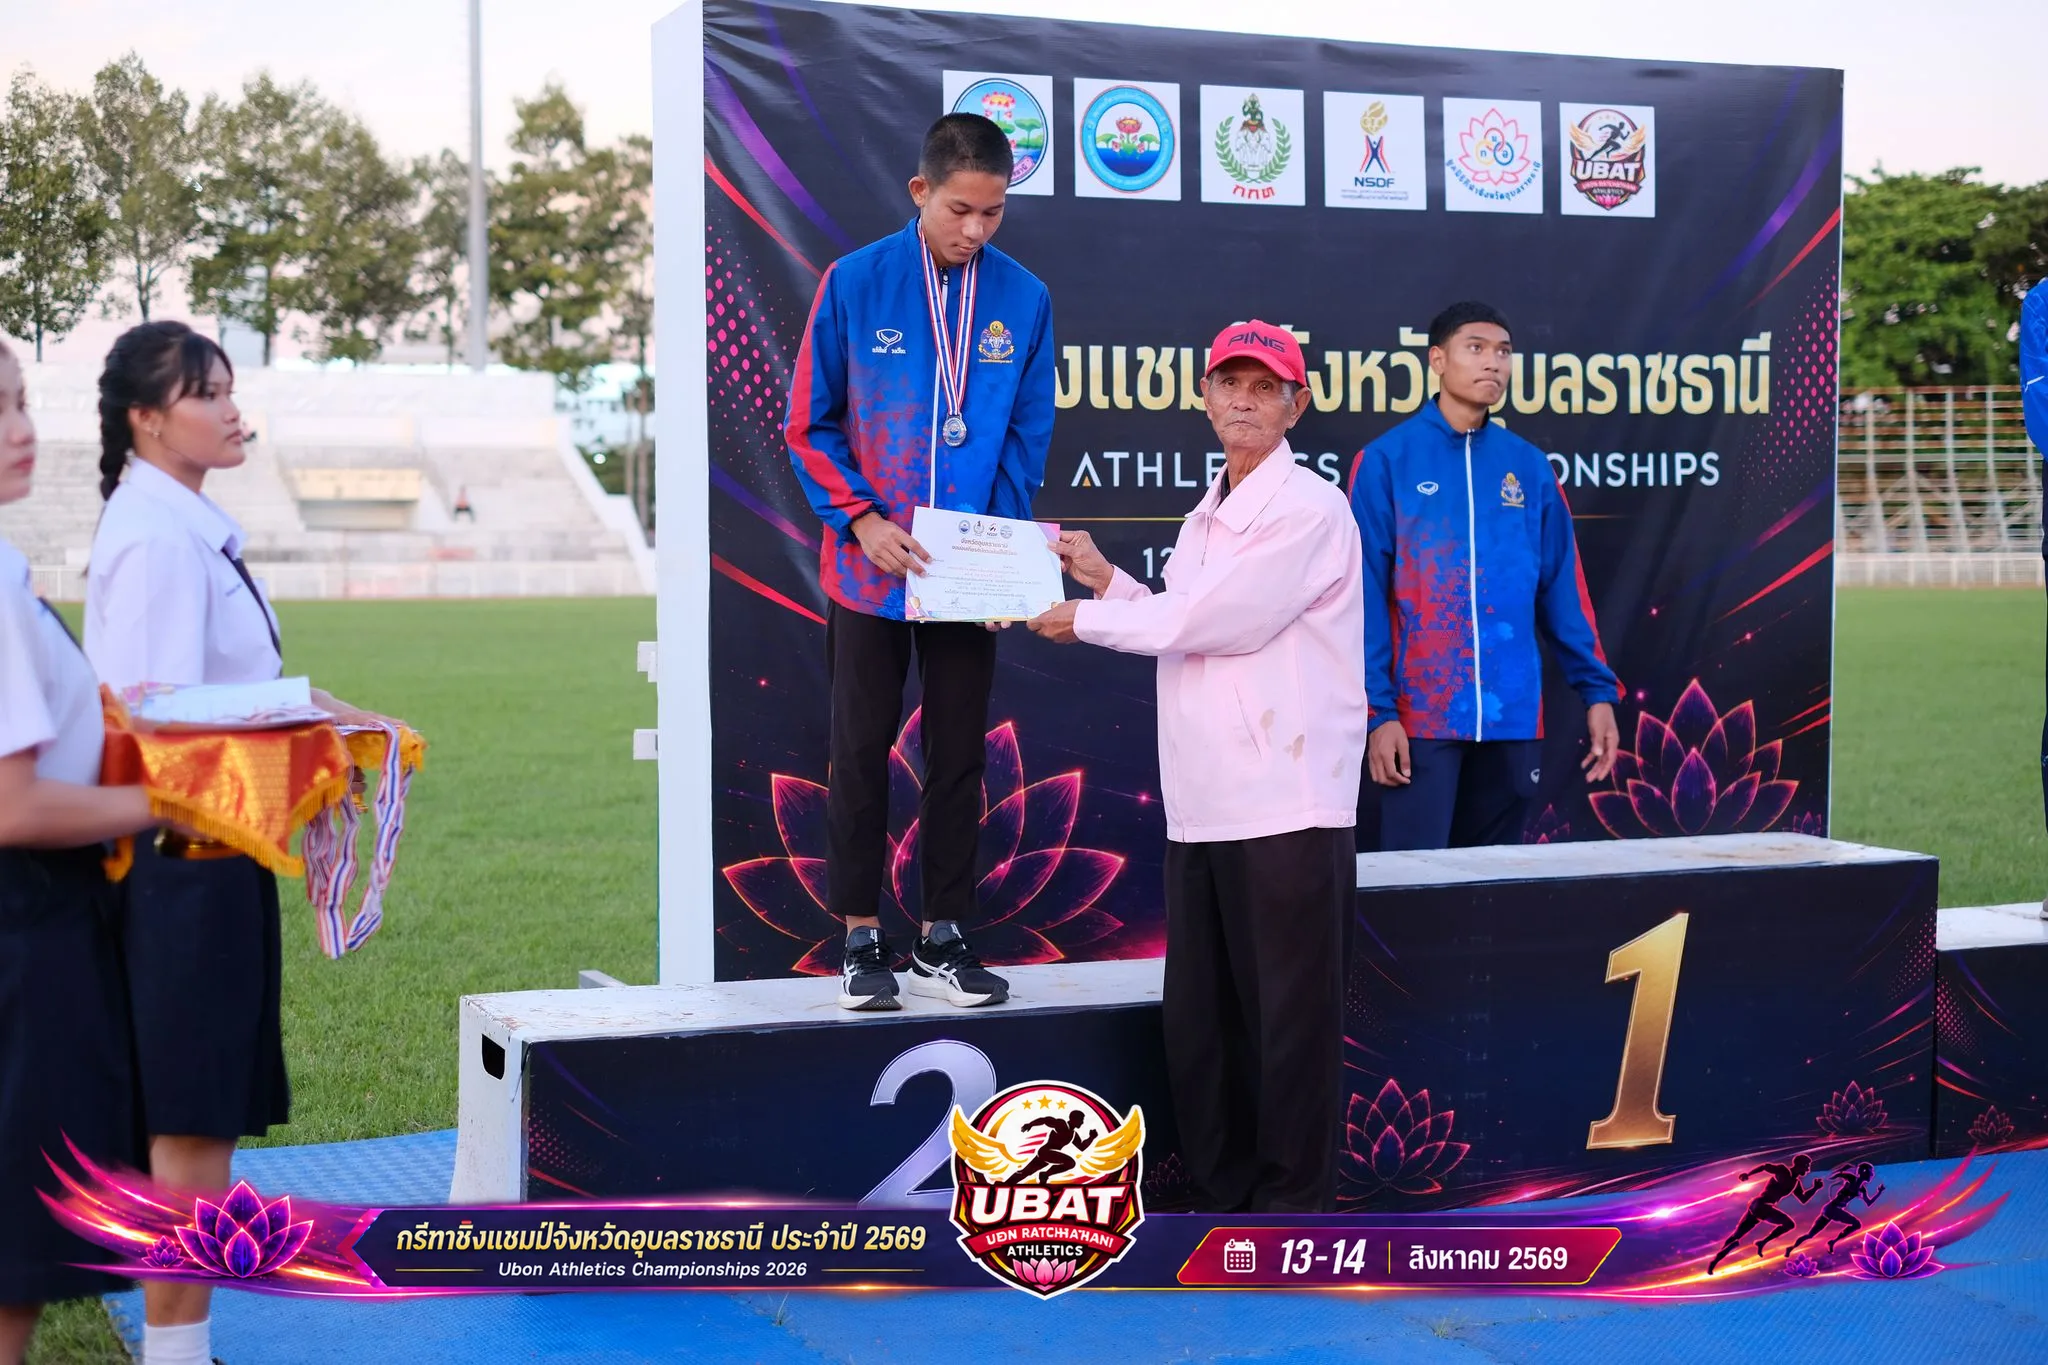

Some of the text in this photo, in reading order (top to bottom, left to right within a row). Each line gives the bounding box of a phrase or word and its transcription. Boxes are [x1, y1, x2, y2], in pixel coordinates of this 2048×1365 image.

[1354, 176, 1395, 188] NSDF
[1576, 160, 1640, 182] UBAT
[1232, 184, 1275, 200] กกท
[1227, 331, 1286, 353] PING
[1586, 912, 1690, 1150] 1
[859, 1040, 997, 1208] 2
